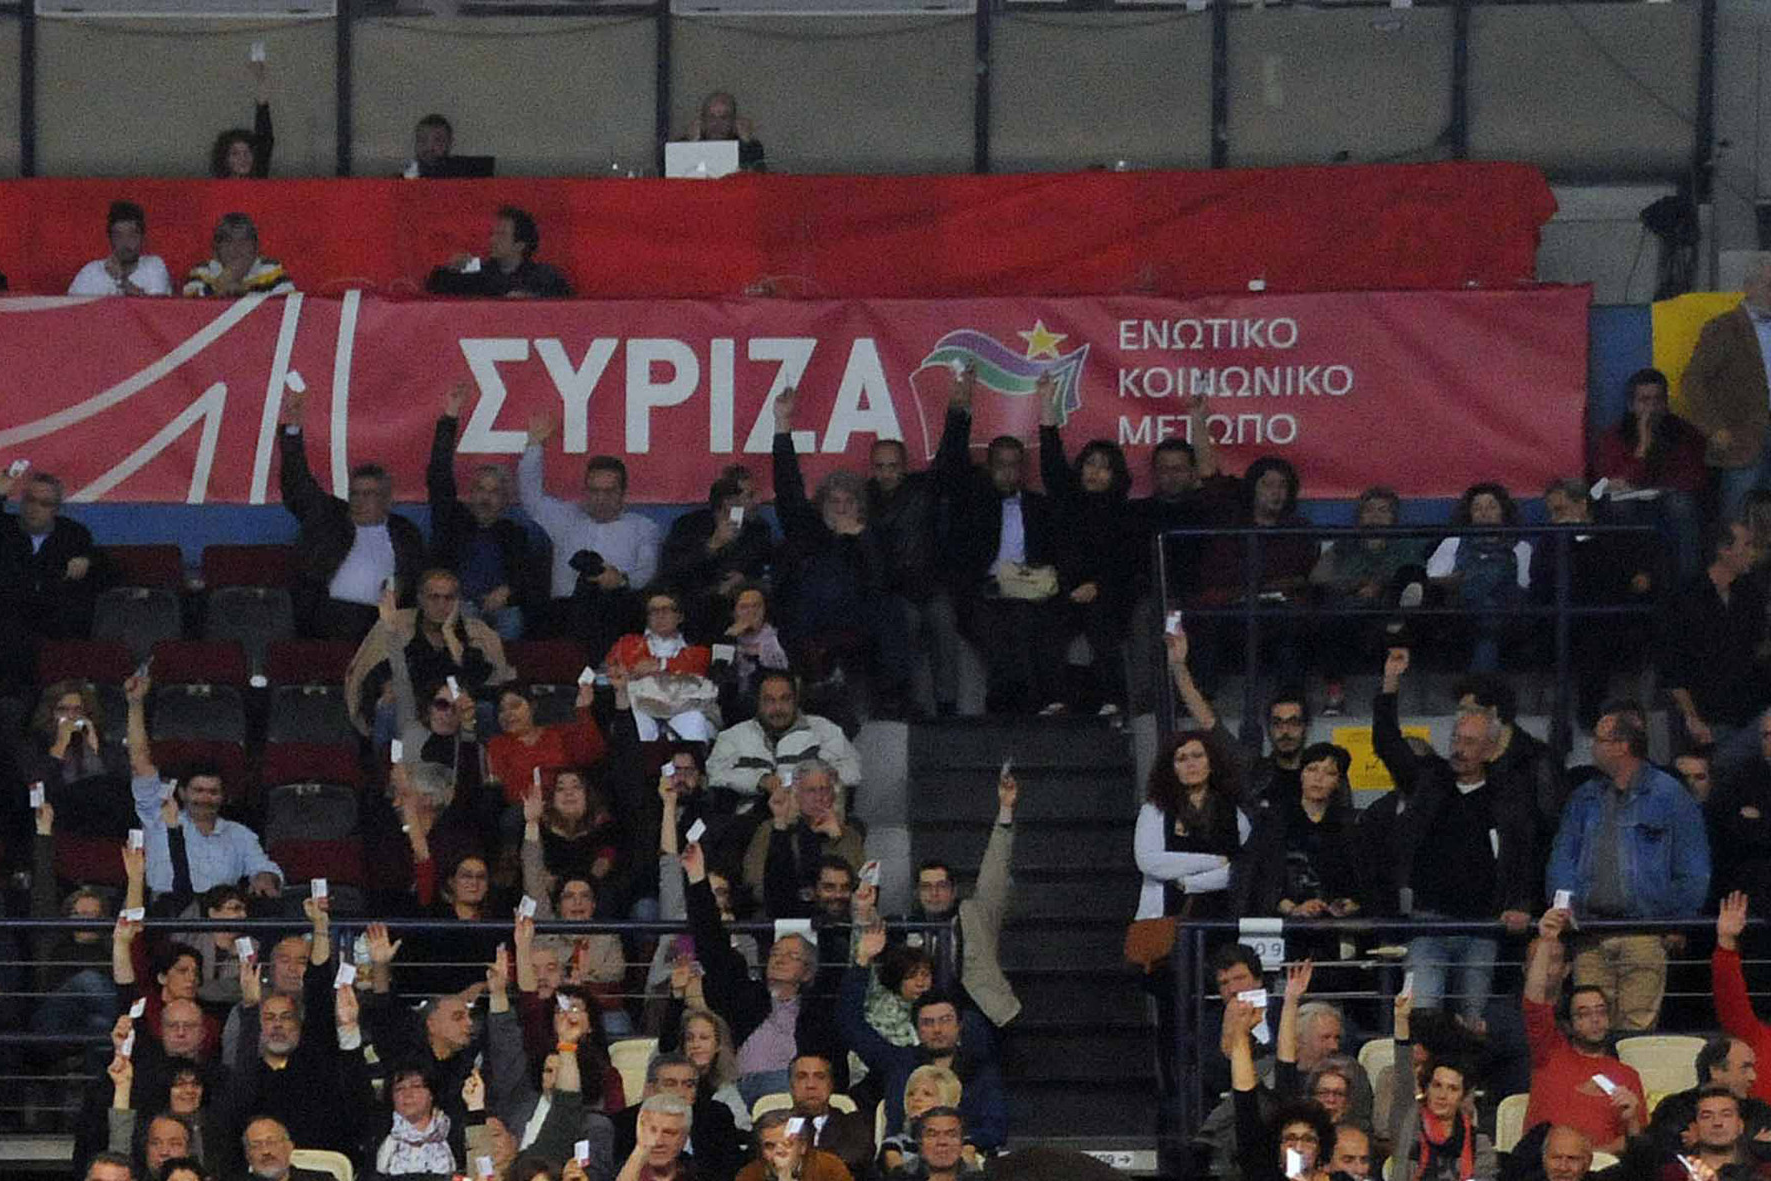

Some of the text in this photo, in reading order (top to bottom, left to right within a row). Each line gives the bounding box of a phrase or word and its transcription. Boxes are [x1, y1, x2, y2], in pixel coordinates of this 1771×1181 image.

[1118, 317, 1299, 350] ΕΝΩΤΙΚΟ
[455, 337, 905, 455] ΣΥΡΙΖΑ
[1118, 364, 1355, 398] ΚΟΙΝΩΝΙΚΟ
[1118, 412, 1299, 446] ΜΕΤΩΠΟ
[1252, 942, 1282, 957] 09
